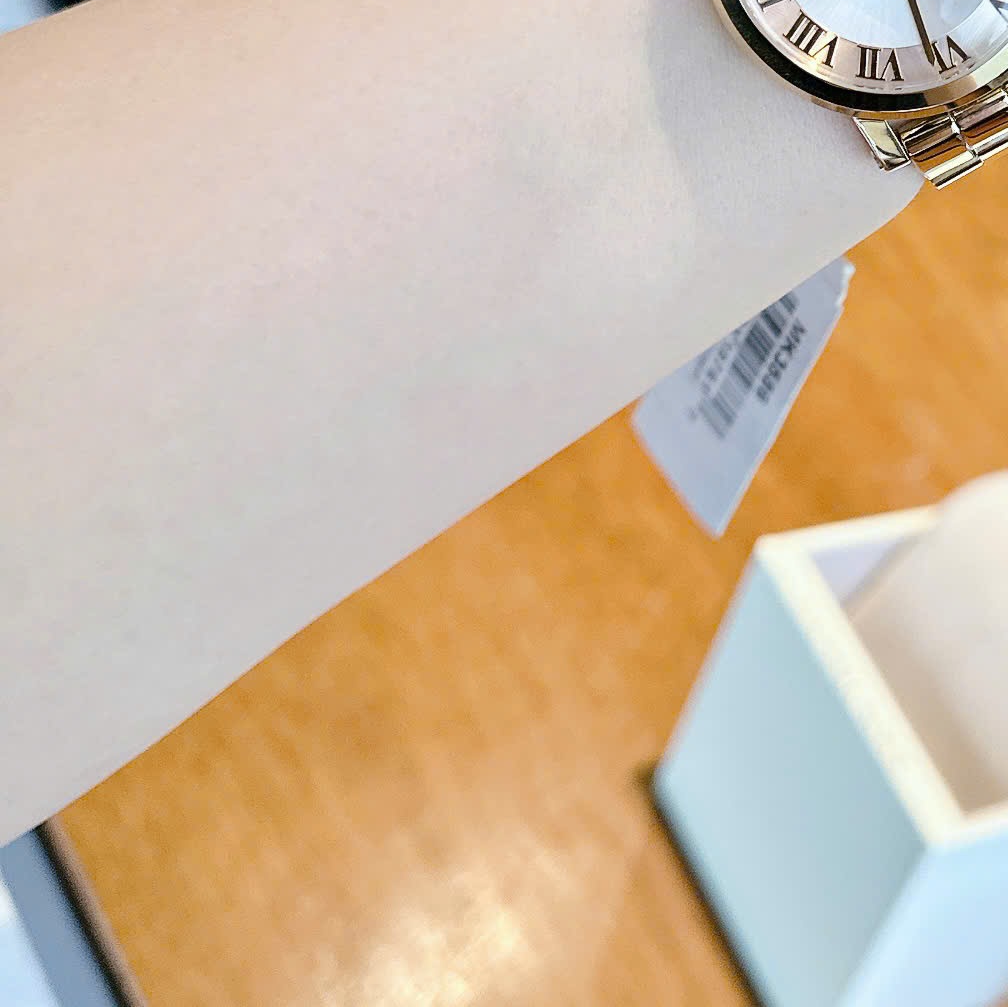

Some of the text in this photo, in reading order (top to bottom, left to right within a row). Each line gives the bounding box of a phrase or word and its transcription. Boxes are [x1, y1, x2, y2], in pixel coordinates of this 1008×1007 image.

[783, 8, 839, 68] VIII
[930, 35, 972, 74] VI
[855, 43, 905, 81] VII
